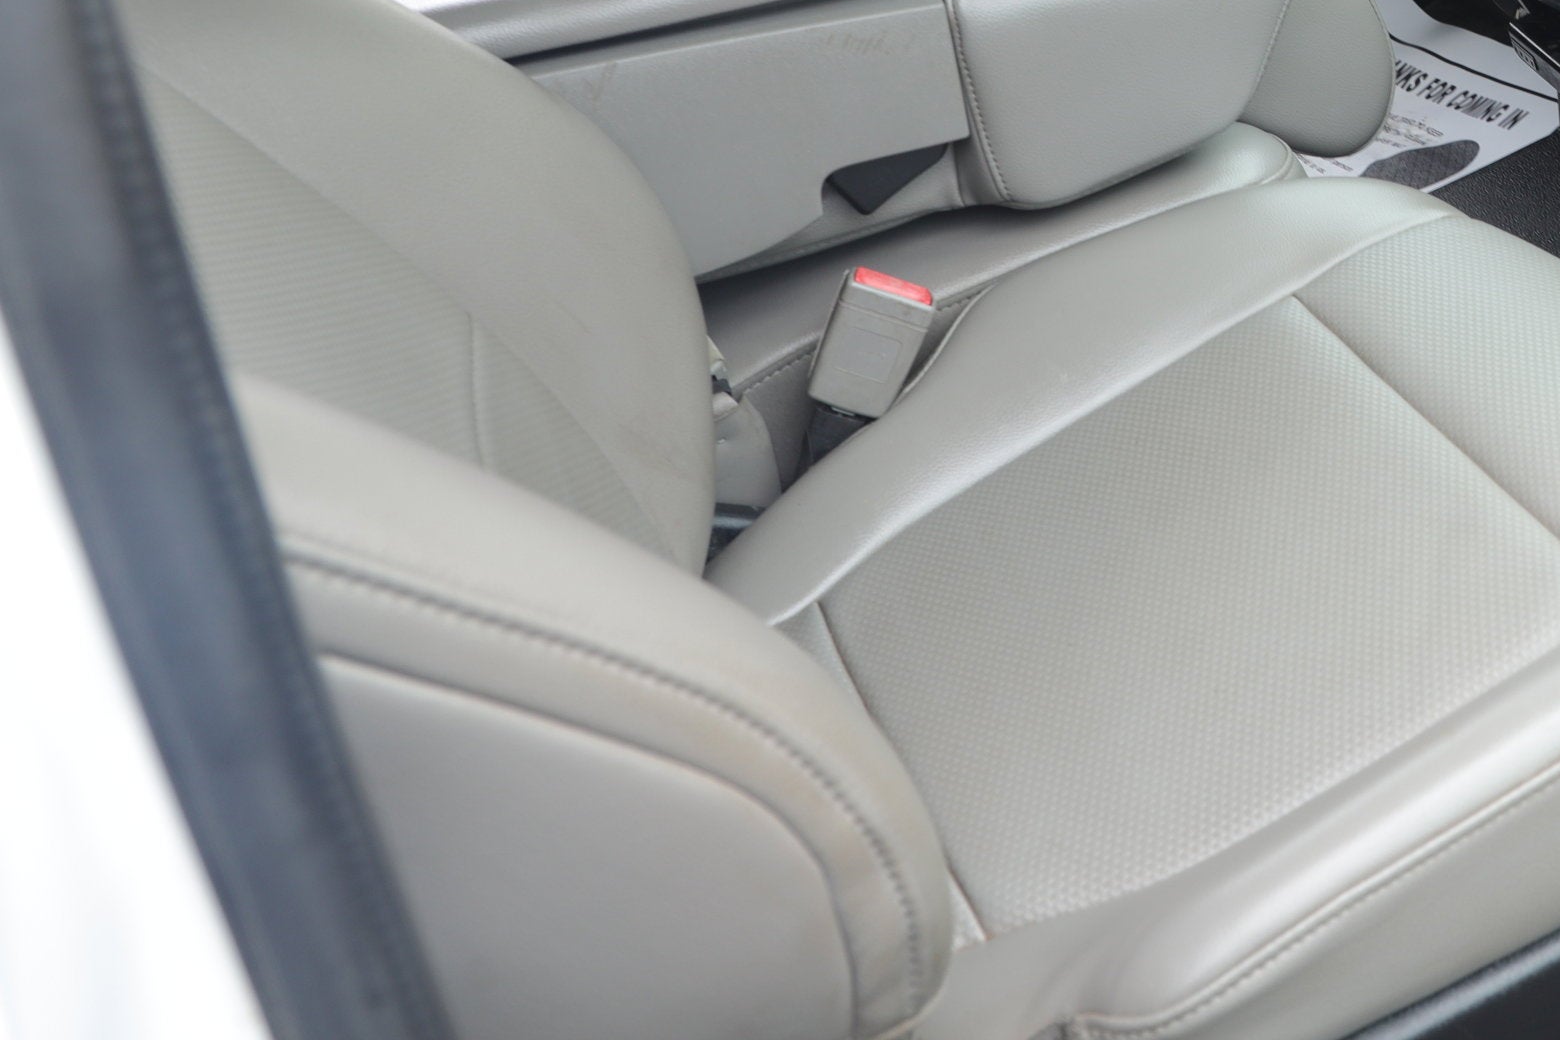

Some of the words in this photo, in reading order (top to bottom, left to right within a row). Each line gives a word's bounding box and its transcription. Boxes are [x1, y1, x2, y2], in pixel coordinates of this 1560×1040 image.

[1416, 77, 1457, 105] FOR
[1446, 89, 1511, 123] COMING
[1497, 106, 1531, 130] IN
